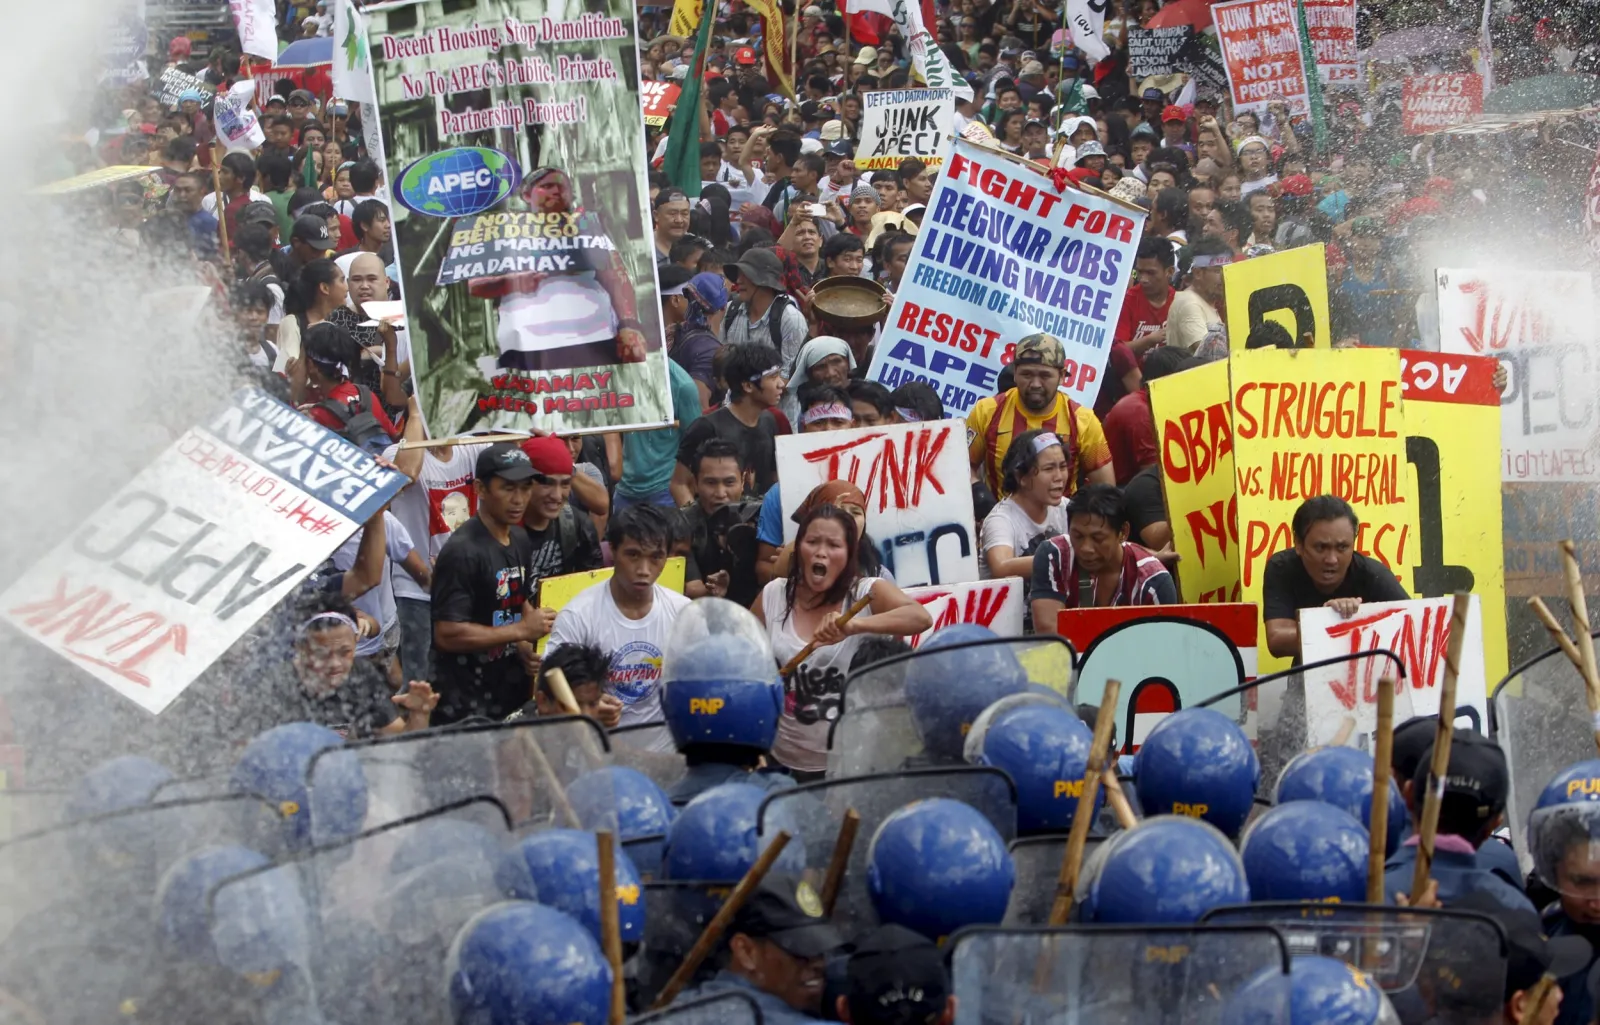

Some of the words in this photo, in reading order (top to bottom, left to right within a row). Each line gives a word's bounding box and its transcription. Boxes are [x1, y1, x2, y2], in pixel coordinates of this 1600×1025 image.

[383, 30, 434, 60] Decent
[438, 23, 502, 53] Housing,
[505, 19, 536, 48] Stop
[541, 14, 626, 41] Demolition.
[1221, 6, 1254, 32] JUNK
[1255, 2, 1290, 27] APEC!
[1263, 27, 1298, 55] Health
[402, 74, 423, 99] No
[426, 71, 445, 95] To
[449, 62, 505, 93] APEC's
[507, 58, 555, 87] Public,
[560, 55, 617, 82] Private,
[1239, 77, 1298, 100] PROFIT!
[1242, 61, 1285, 80] NOT
[441, 100, 523, 135] Partnership
[526, 98, 578, 127] Project
[866, 91, 903, 108] DEFEND
[905, 89, 953, 103] PATRIMONY!
[876, 105, 941, 138] JUNK
[871, 132, 940, 156] APEC!
[427, 168, 491, 196] APEC
[947, 153, 1061, 218] FIGHT
[1063, 203, 1135, 244] FOR
[472, 212, 581, 231] NOYNOY
[932, 187, 1052, 264] REGULAR
[1047, 235, 1122, 286] JOBS
[450, 243, 485, 259] NG
[921, 228, 1020, 291] LIVING
[1024, 267, 1112, 322] WAGE
[912, 263, 989, 307] FREEDOM
[988, 290, 1011, 314] OF
[1008, 297, 1105, 349] ASSOCIATION
[1458, 279, 1554, 353] JUN
[888, 338, 998, 391] APE
[897, 301, 1001, 360] RESIST
[1061, 358, 1096, 392] OP
[478, 395, 537, 416] Metro
[543, 391, 635, 414] Manila
[491, 371, 612, 394] KADAMAY
[1488, 343, 1594, 436] PEC
[243, 388, 328, 450] MANILA
[1236, 380, 1398, 439] STRUGGLE
[210, 406, 378, 512] BAYAN
[320, 438, 396, 489] METRO
[1163, 400, 1233, 485] OBA
[1503, 446, 1596, 477] ightAPEC
[802, 427, 951, 513] JUNK
[1237, 465, 1264, 496] VS.
[1269, 452, 1405, 506] NEOLIBERAL
[73, 490, 306, 622] APEC
[9, 575, 188, 687] JUNK
[1325, 605, 1452, 711] JUNK
[689, 698, 725, 715] PNP
[1172, 802, 1209, 819] PNP
